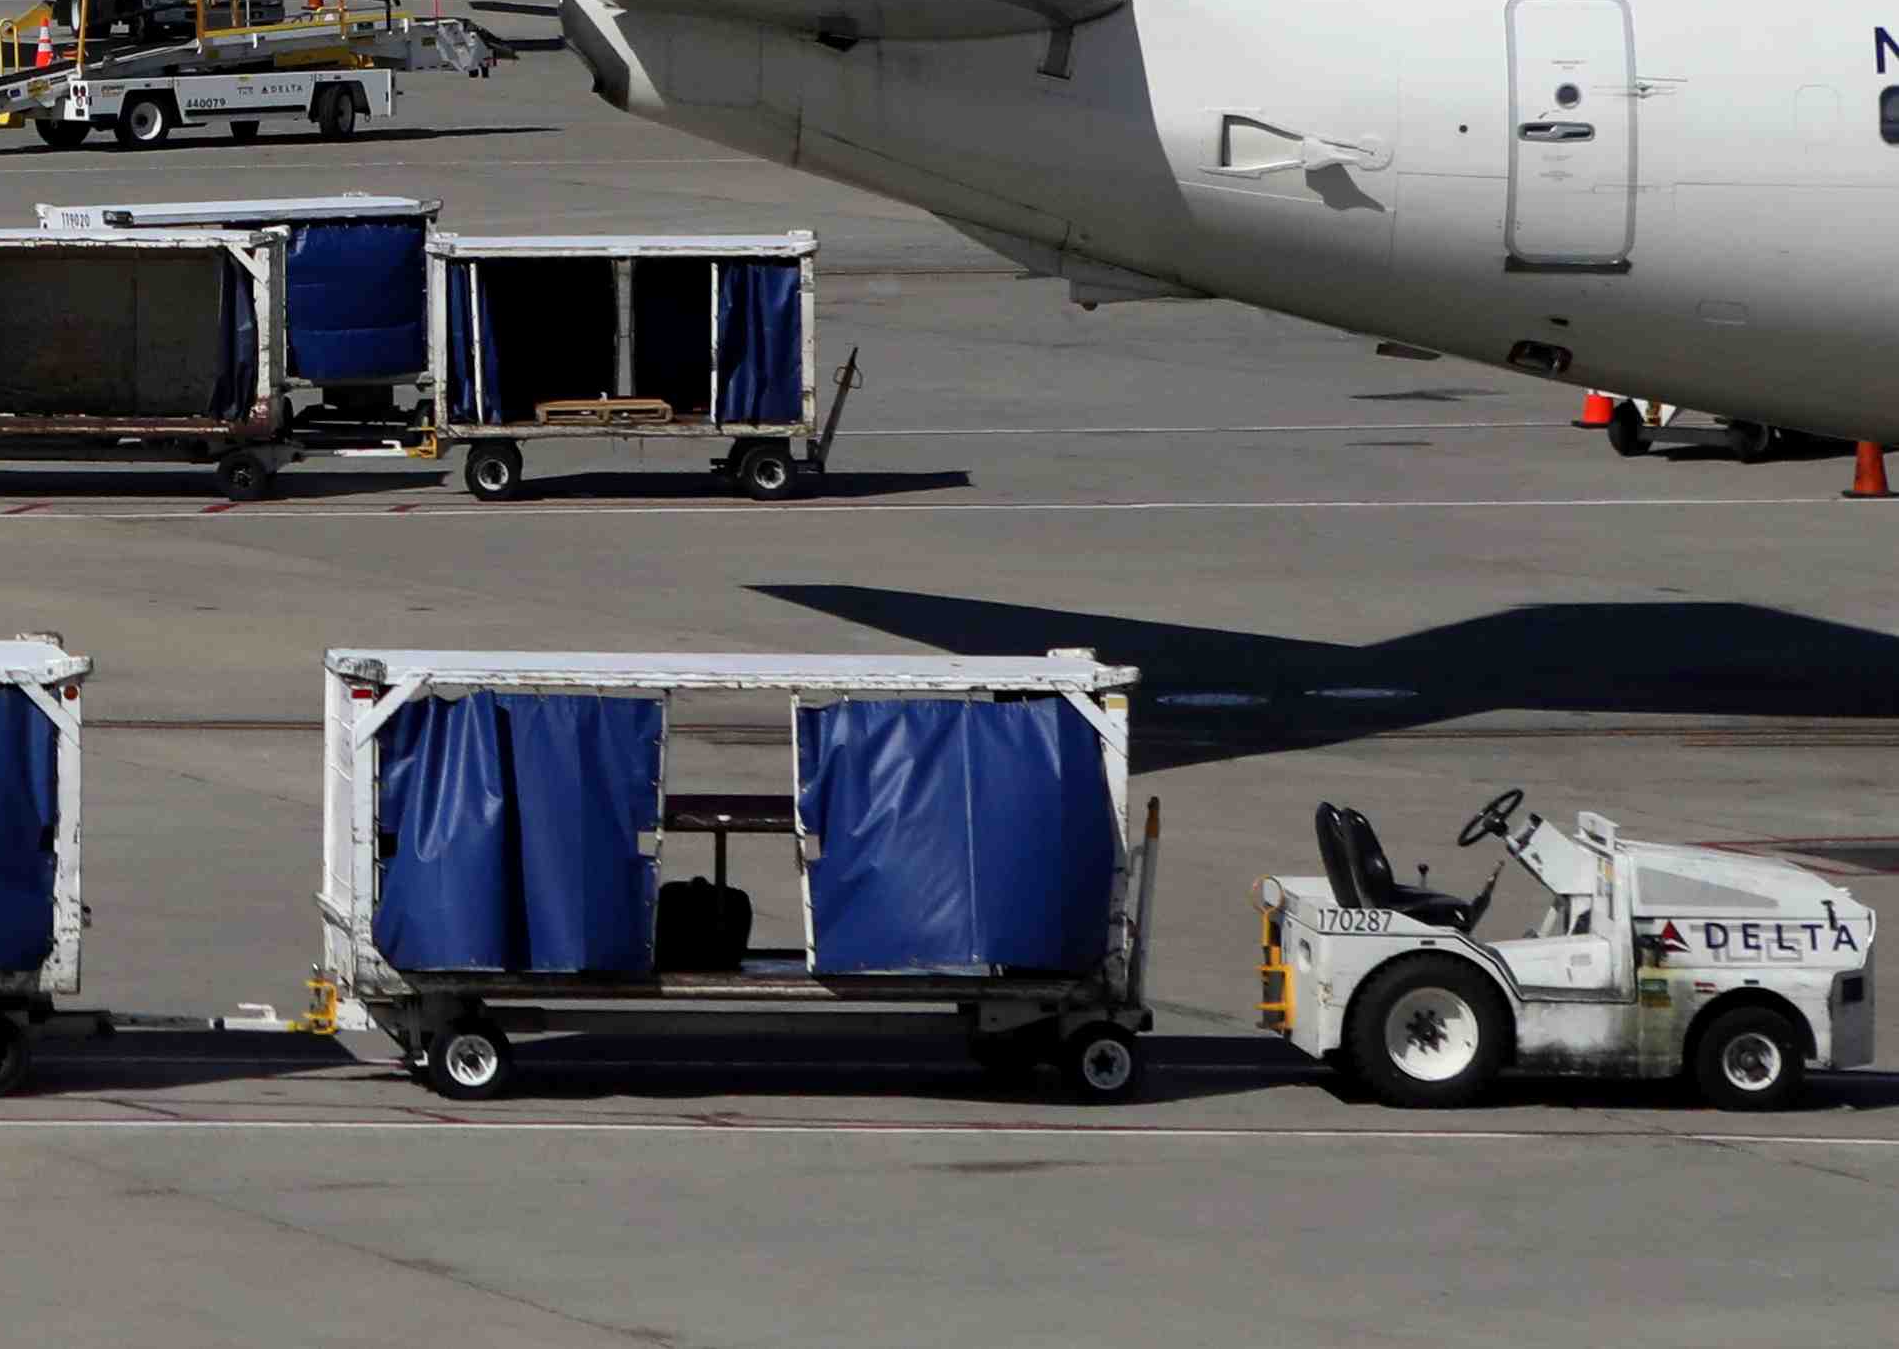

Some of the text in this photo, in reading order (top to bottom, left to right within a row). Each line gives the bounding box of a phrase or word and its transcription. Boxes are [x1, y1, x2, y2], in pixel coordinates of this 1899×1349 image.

[269, 85, 303, 95] DELTA
[185, 97, 226, 109] 440079
[1318, 909, 1393, 932] 170287
[1705, 922, 1858, 951] DELTA
